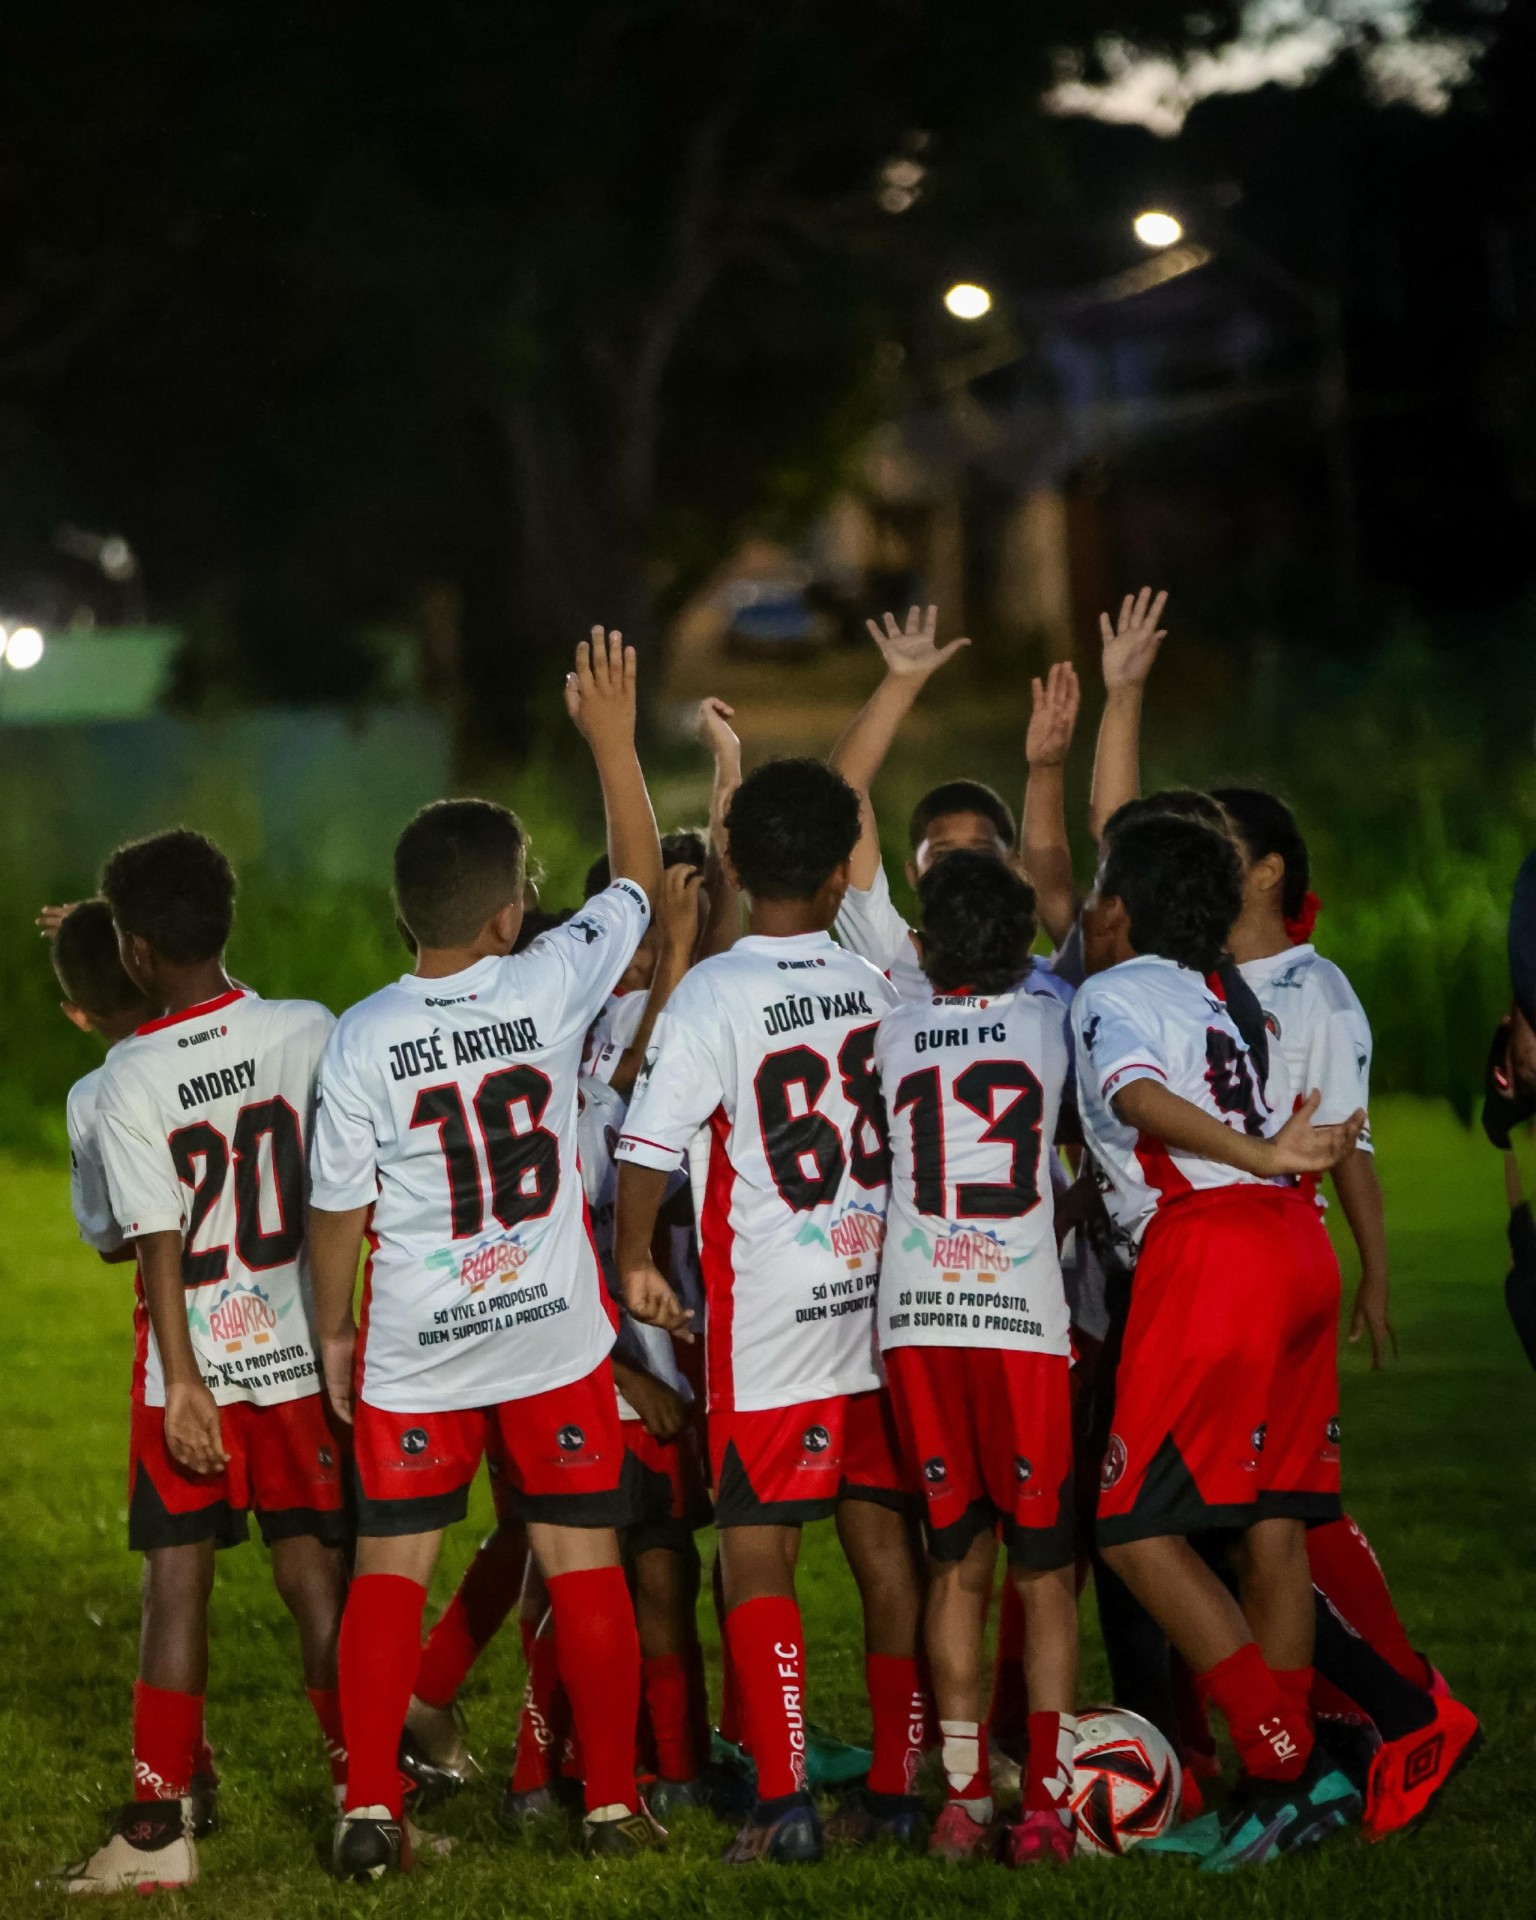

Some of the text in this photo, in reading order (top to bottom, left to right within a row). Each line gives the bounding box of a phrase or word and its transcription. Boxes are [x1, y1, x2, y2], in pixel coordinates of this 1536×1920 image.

[763, 990, 873, 1036] JOÃO VIANA
[389, 1016, 545, 1081] JOSÉ ARTHUR
[914, 1022, 1007, 1054] GURI FC
[178, 1058, 256, 1110] ANDREY
[408, 1064, 559, 1240] 16
[893, 1059, 1045, 1220] 13
[167, 1095, 303, 1291] 20
[813, 1282, 828, 1301] SÓ
[830, 1279, 854, 1298] VIVE
[855, 1277, 864, 1291] O
[899, 1289, 912, 1306] SÓ
[946, 1292, 955, 1306] O
[959, 1292, 1030, 1313] PROPÓSITO.
[451, 1303, 476, 1322] VIVE
[478, 1300, 487, 1315] O
[796, 1304, 828, 1324] QUEM
[913, 1312, 968, 1328] SUPORTA
[972, 1314, 981, 1329] O
[417, 1329, 451, 1347] QUEM
[452, 1317, 504, 1341] SUPORTA
[505, 1314, 514, 1328] O
[235, 1360, 244, 1373] O
[245, 1343, 308, 1371] PROPÓSITO.
[774, 1642, 806, 1750] GURI F.C
